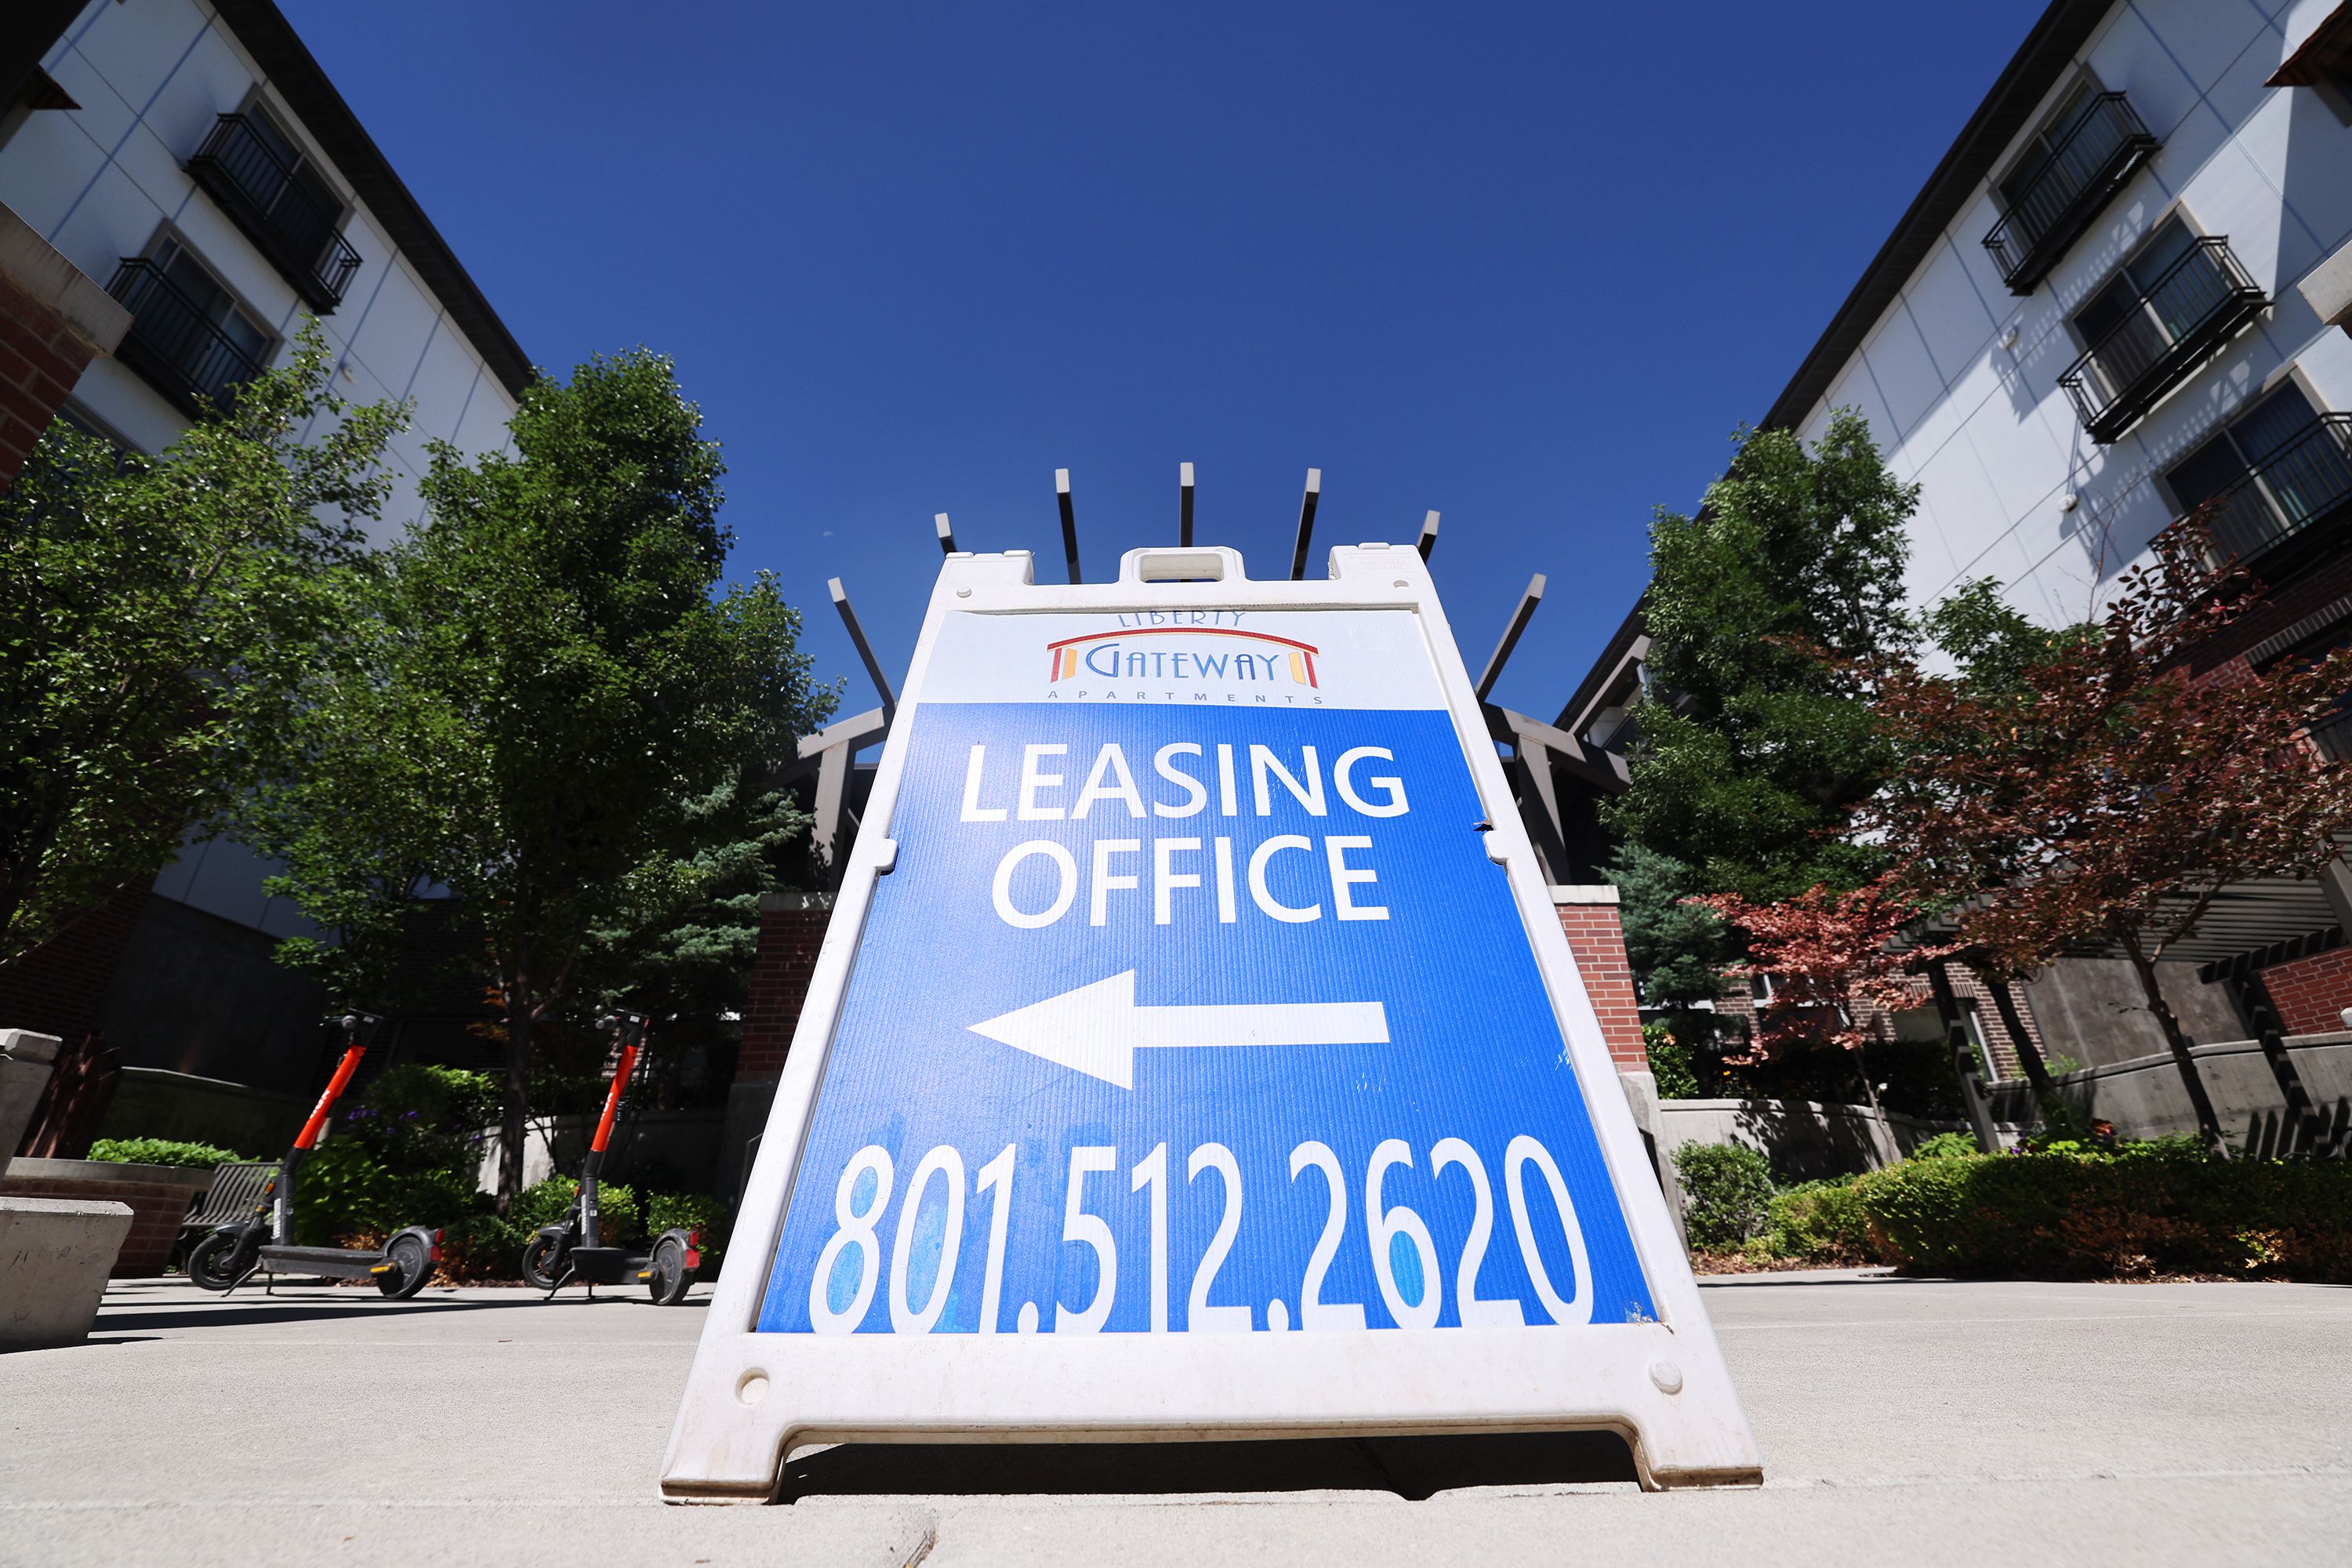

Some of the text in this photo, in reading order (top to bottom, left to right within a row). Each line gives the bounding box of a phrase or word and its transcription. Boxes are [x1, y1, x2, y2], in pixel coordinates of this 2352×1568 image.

[1118, 611, 1247, 627] LIBERTY
[1086, 643, 1279, 681] GATEWAY
[1047, 690, 1323, 704] APARTMENTS
[960, 742, 1410, 822] LEASING
[992, 835, 1390, 929] OFFICE
[809, 1134, 1594, 1333] 801.512.2620
